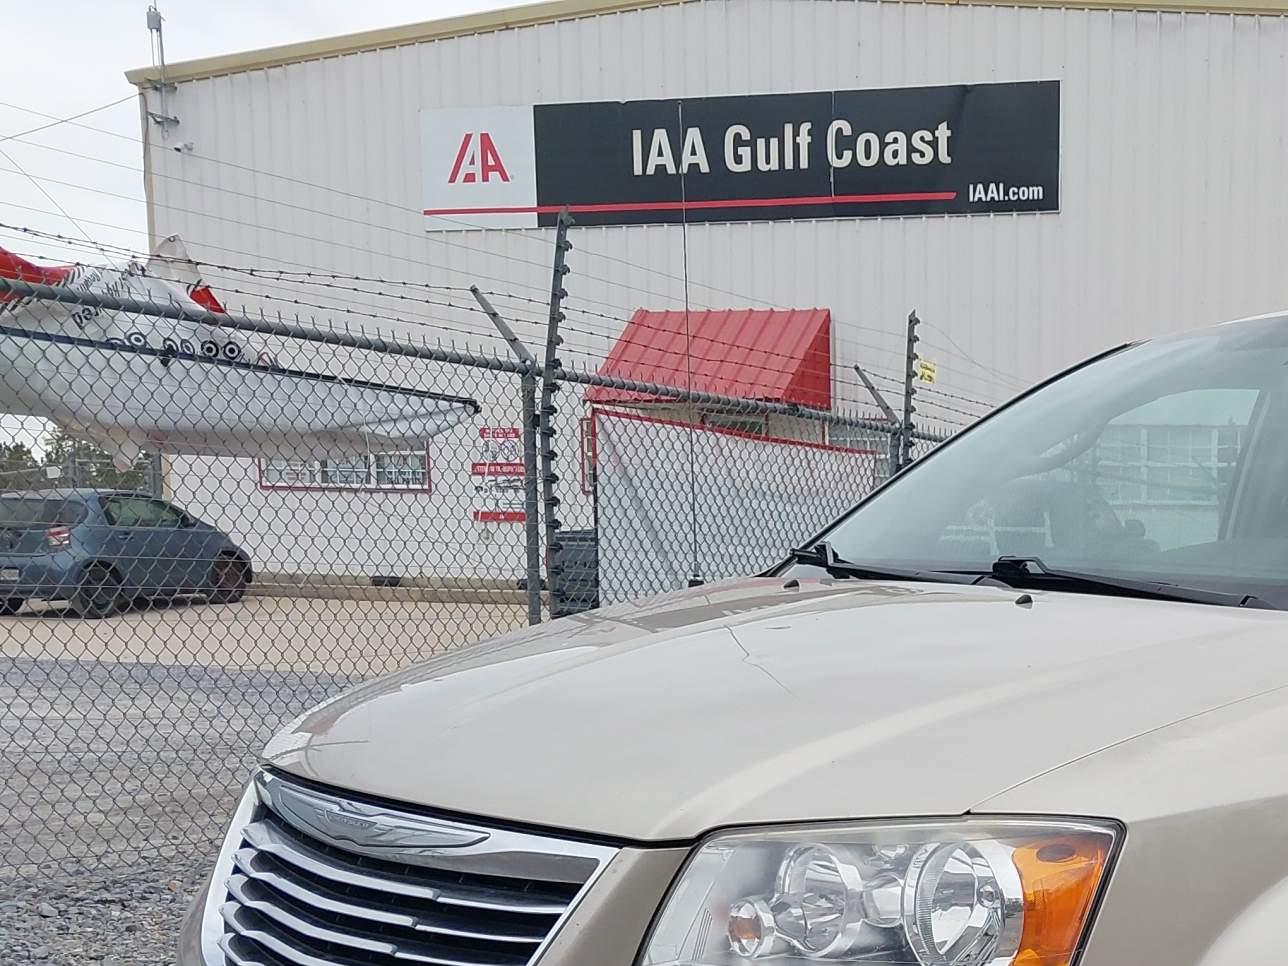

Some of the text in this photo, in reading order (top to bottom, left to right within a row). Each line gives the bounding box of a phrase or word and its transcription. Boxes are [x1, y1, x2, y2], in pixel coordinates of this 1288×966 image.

[632, 119, 952, 176] IAA Gulf Coast
[968, 183, 1044, 203] IAAI.com
